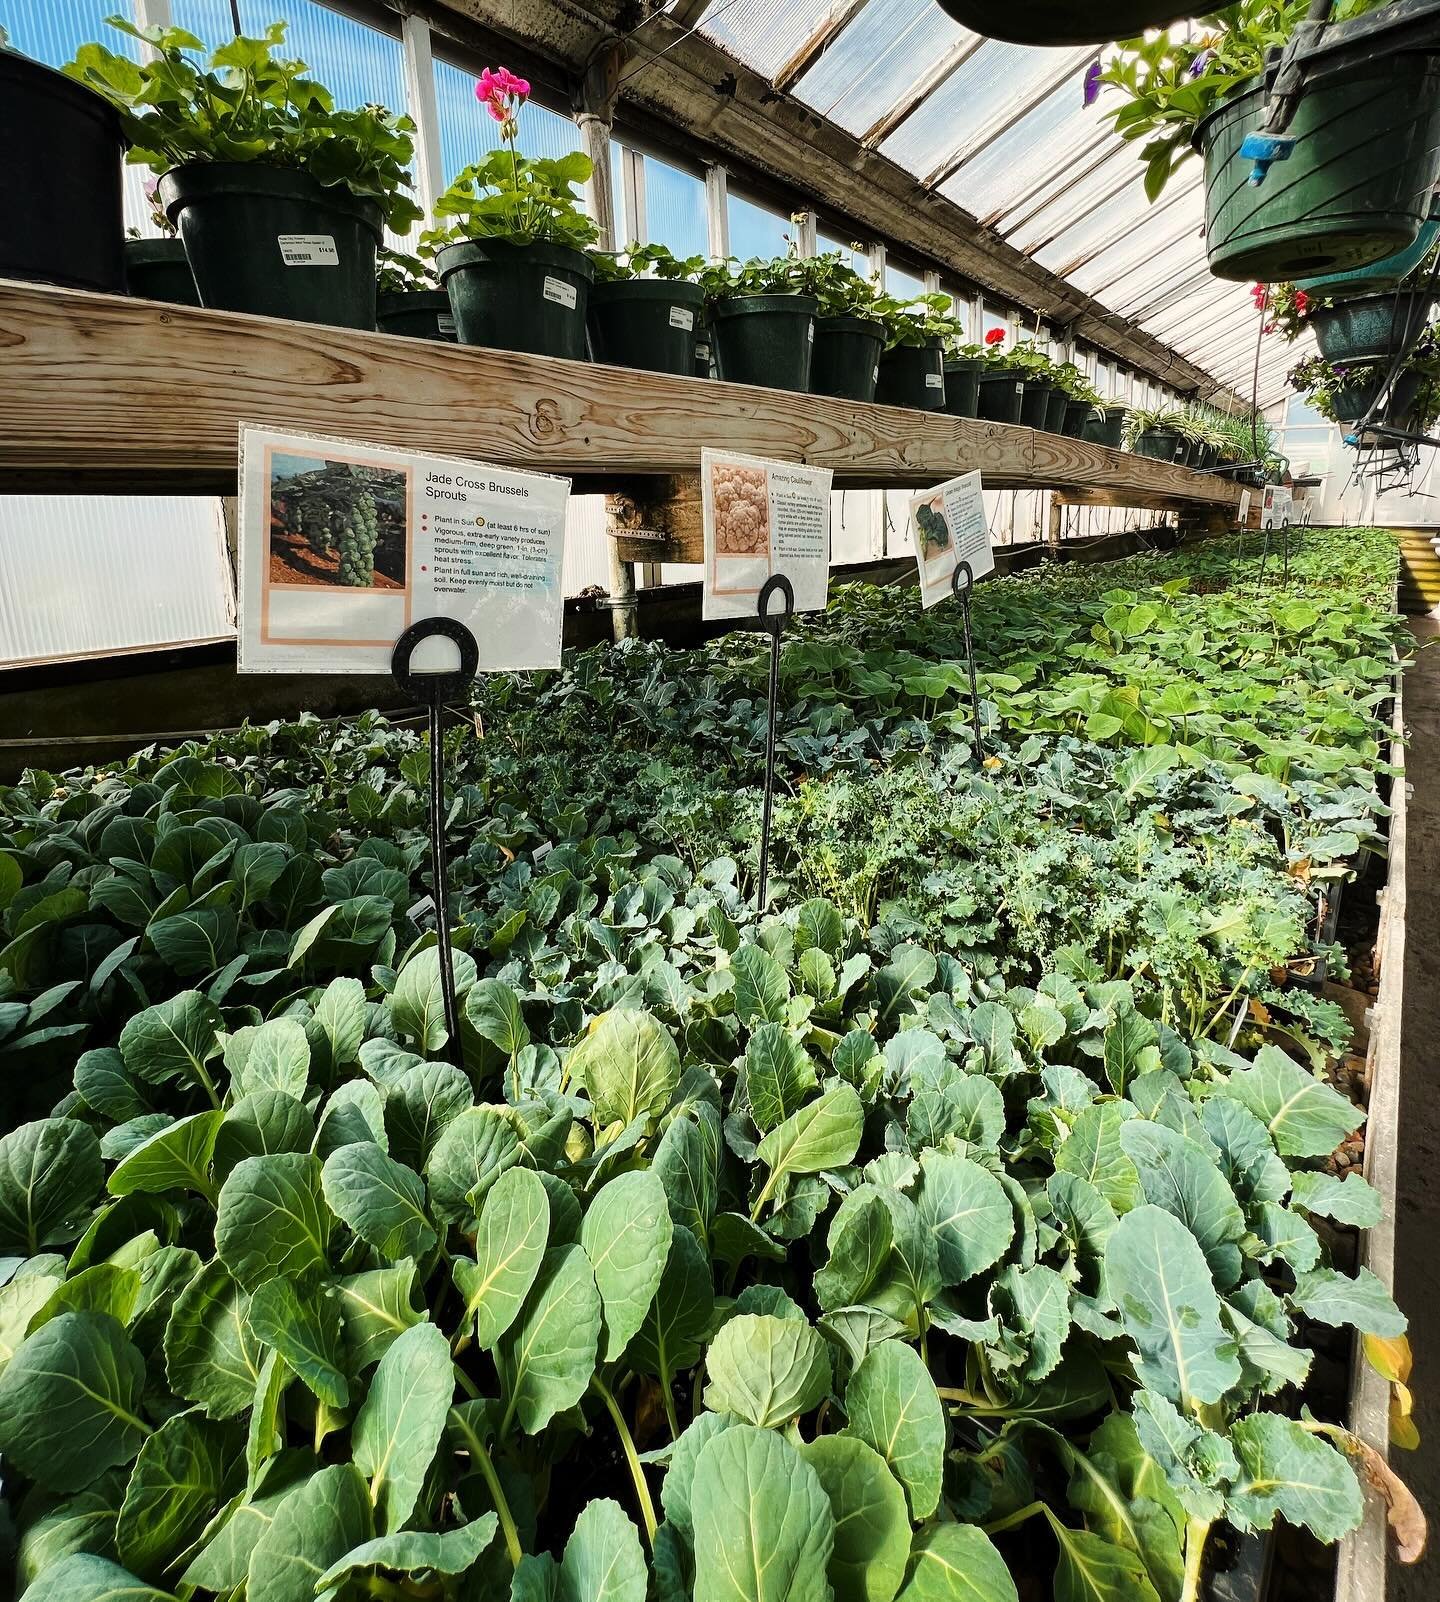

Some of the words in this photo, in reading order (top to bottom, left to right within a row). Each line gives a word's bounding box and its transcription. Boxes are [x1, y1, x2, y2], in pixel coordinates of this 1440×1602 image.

[425, 471, 453, 485] Jade
[455, 476, 486, 491] Cross
[488, 481, 529, 498] Brussels
[425, 486, 467, 502] Sprouts
[434, 515, 453, 524] Plant
[453, 517, 460, 525] in
[460, 518, 475, 527] Sun
[486, 521, 496, 530] (at
[497, 523, 513, 531] least
[537, 528, 551, 537] sun)
[434, 526, 466, 538] Vigorous,
[466, 532, 500, 542] extra-early
[500, 535, 520, 544] variety
[520, 537, 546, 546] produces
[434, 537, 478, 549] medium-firm,
[478, 541, 496, 550] deep
[433, 555, 450, 563] heat
[450, 557, 473, 565] stress.
[434, 547, 460, 555] sprouts
[521, 554, 547, 563] Tolerates
[434, 566, 453, 575] Plant
[460, 568, 471, 576] full
[496, 571, 510, 579] rich,
[510, 573, 547, 582] well-draining
[449, 576, 467, 585] Keep
[467, 578, 488, 587] evenly
[505, 580, 516, 588] but
